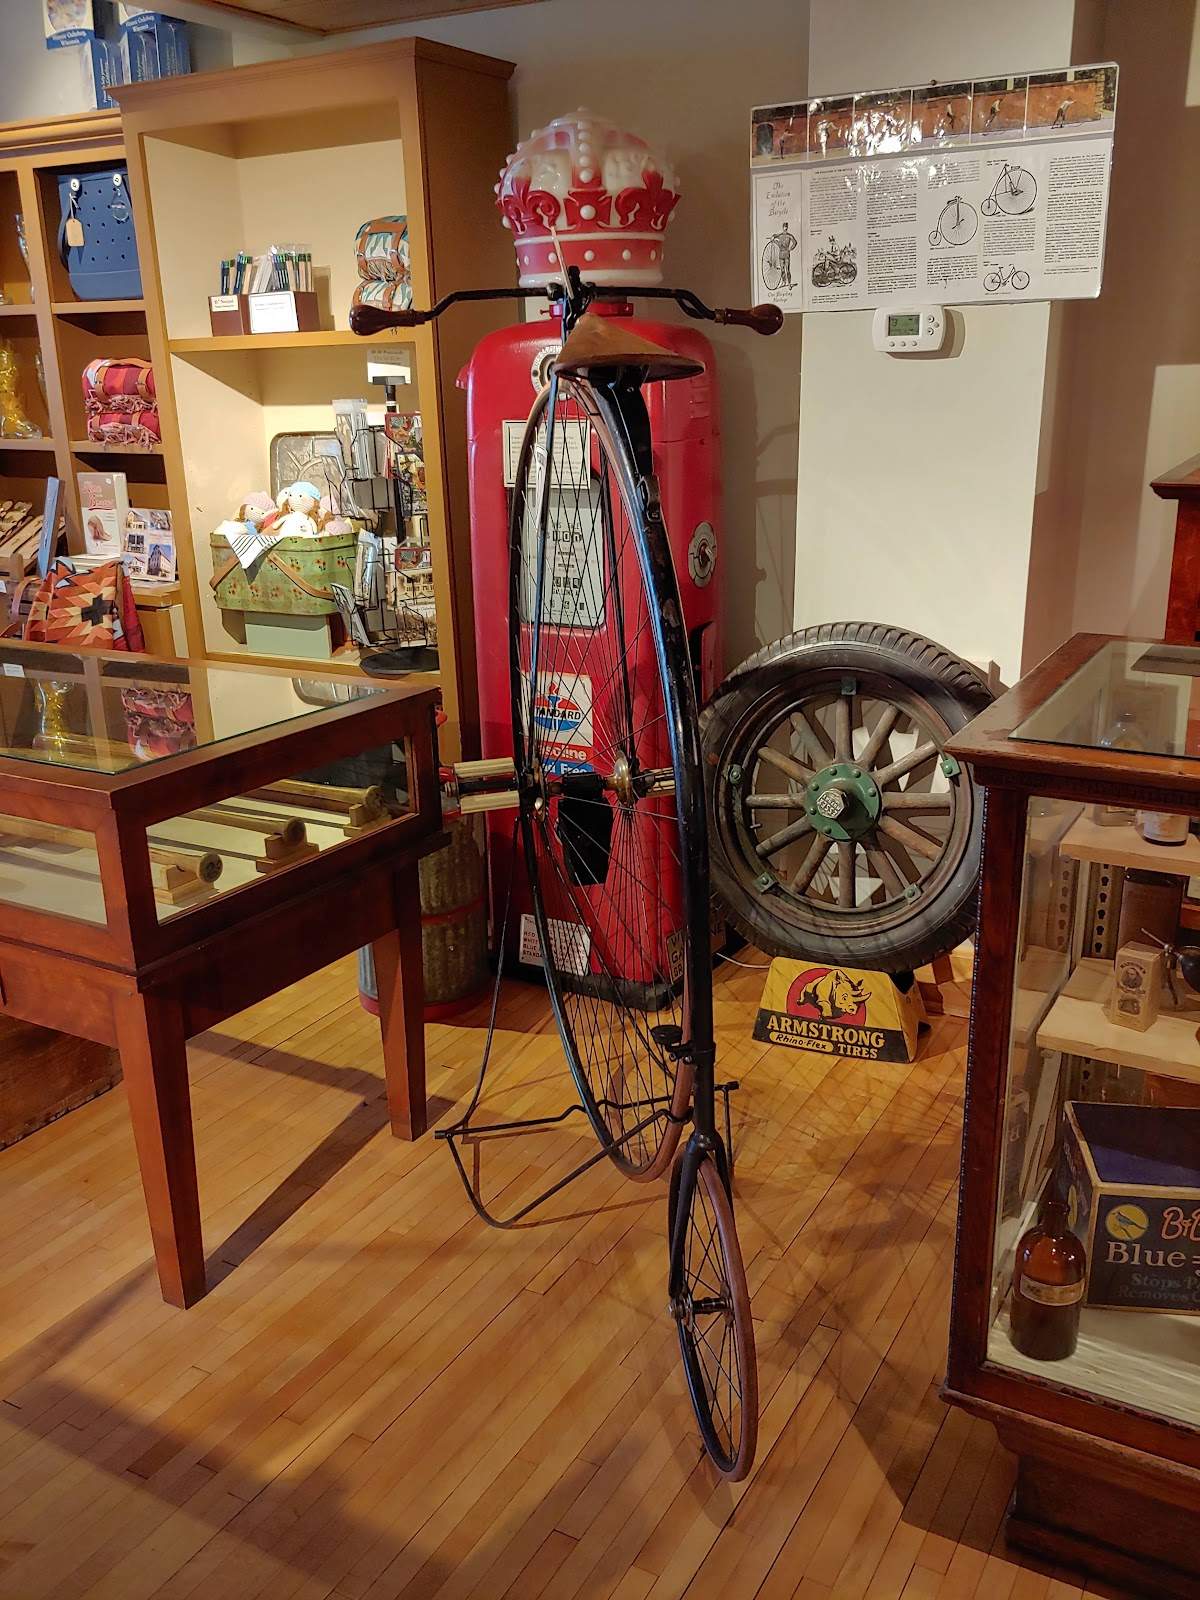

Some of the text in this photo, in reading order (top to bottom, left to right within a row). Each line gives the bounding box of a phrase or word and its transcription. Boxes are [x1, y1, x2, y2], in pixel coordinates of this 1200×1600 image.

[535, 706, 581, 720] TANDARD
[766, 1014, 885, 1048] ARMSTRONG
[775, 1034, 878, 1059] Rhino-Flex TIRES
[1131, 1272, 1182, 1290] Stops
